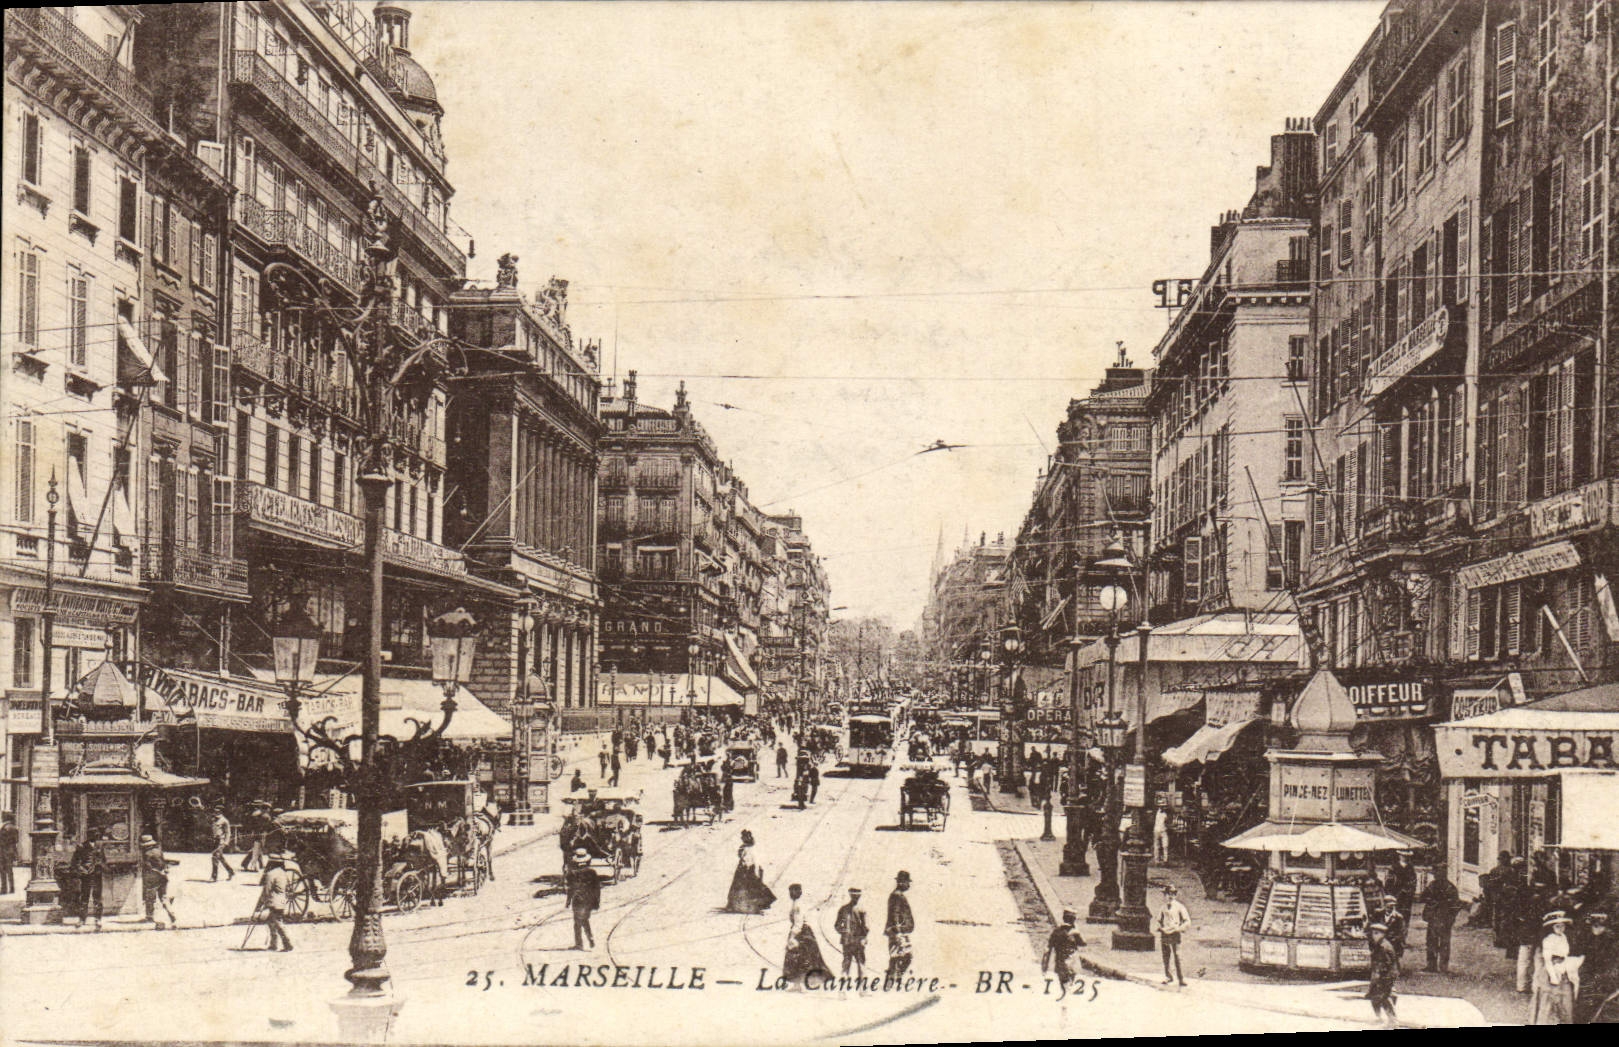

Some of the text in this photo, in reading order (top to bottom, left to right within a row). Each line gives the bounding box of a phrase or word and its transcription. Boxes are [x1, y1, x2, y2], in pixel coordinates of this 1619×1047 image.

[605, 621, 662, 632] GRAND
[1349, 682, 1423, 705] OIFFEUR
[1027, 709, 1072, 722] OPERA
[1472, 734, 1619, 771] TABA
